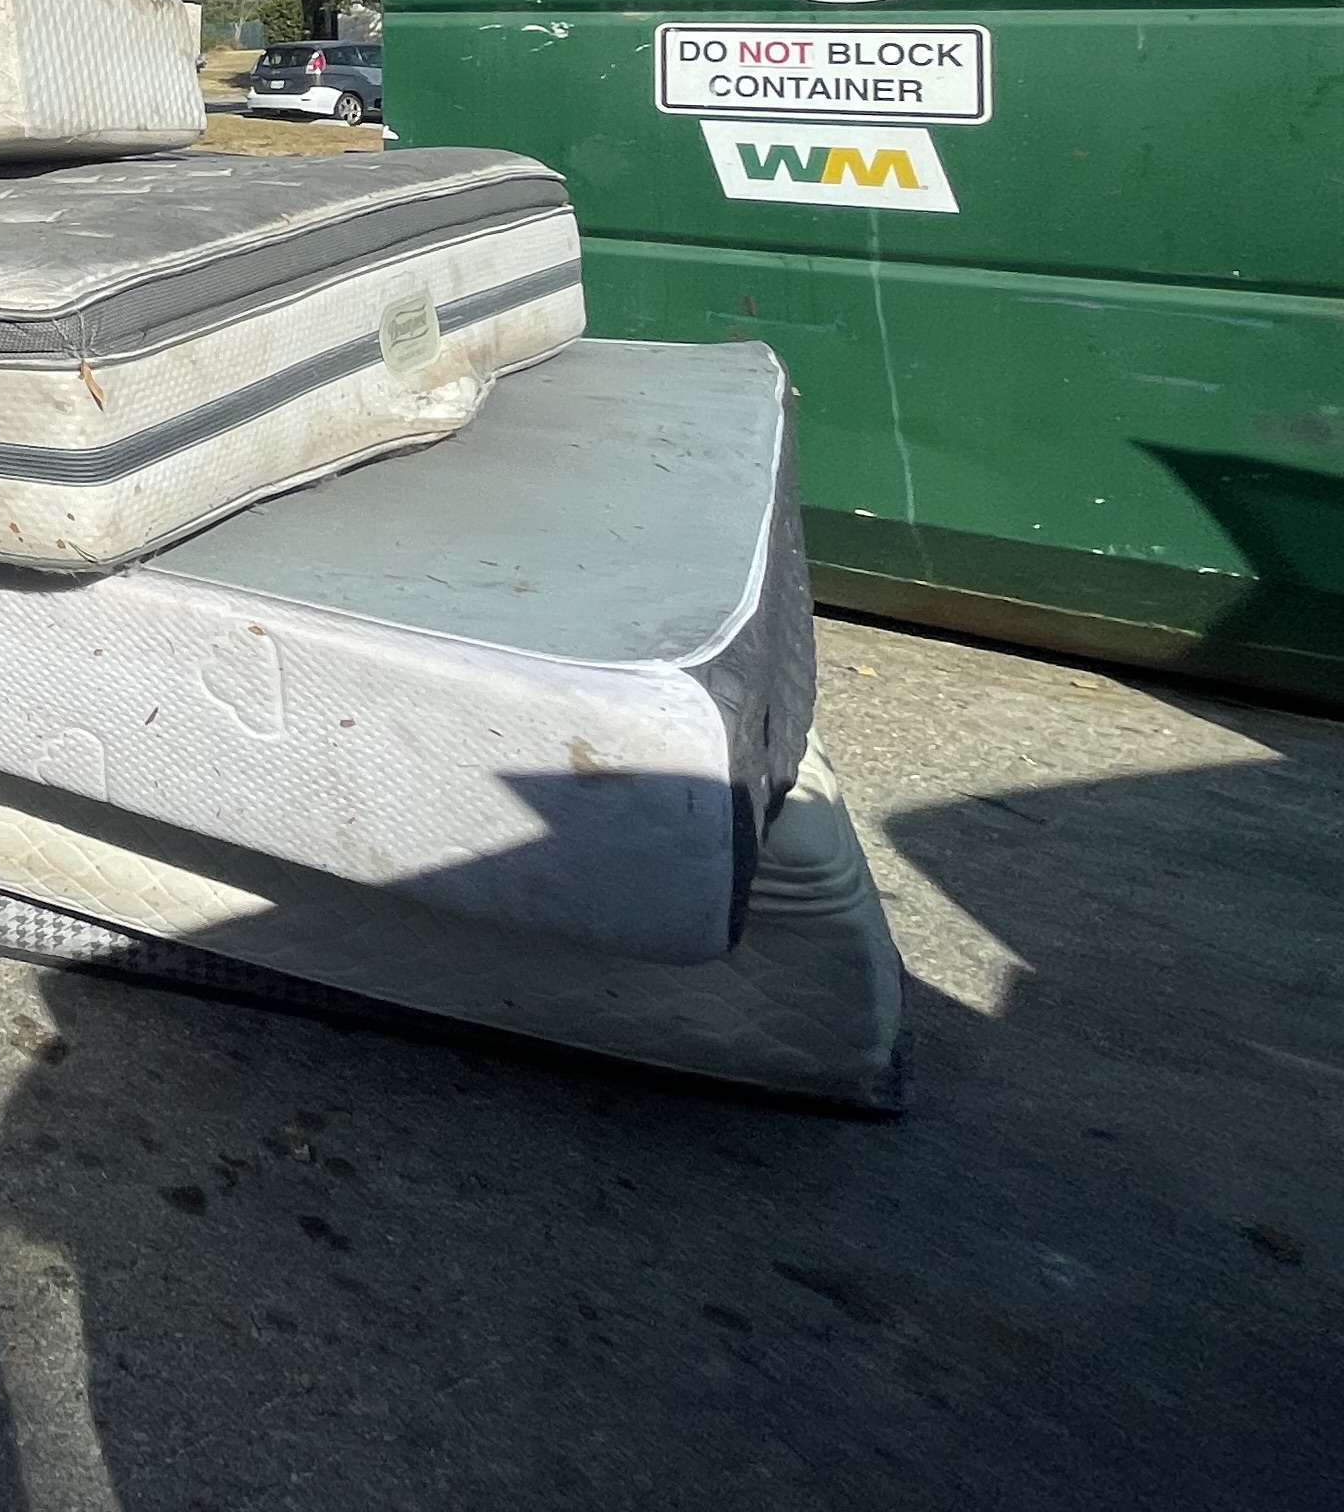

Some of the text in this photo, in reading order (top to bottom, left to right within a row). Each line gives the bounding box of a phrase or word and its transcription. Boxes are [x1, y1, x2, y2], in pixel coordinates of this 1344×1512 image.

[679, 40, 964, 68] DO NOT BLOCK
[708, 74, 924, 103] CONTAINER
[734, 141, 920, 190] WM
